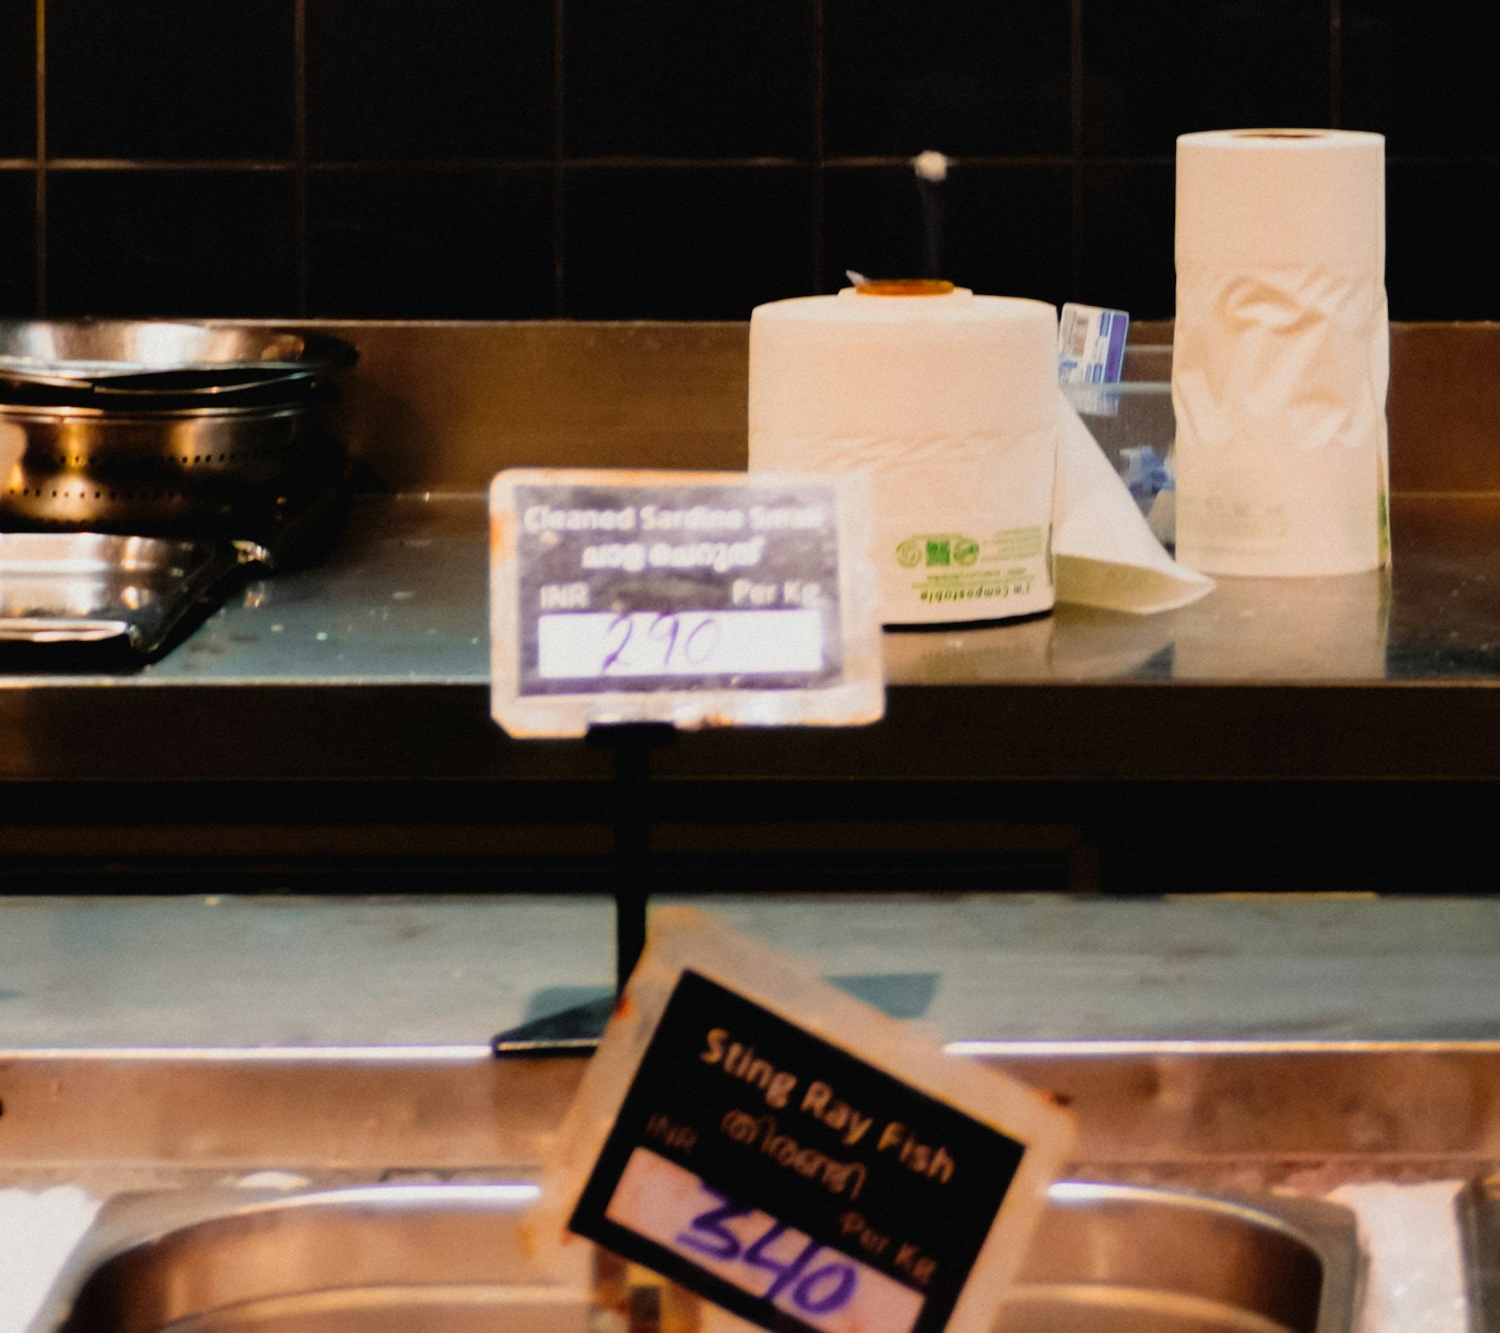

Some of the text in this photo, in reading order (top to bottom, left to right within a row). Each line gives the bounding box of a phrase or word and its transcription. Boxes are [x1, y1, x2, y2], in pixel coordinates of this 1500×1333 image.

[524, 504, 636, 531] Cleaned
[732, 579, 776, 606] Per
[699, 1026, 957, 1186] Sting Ray Fish
[839, 1209, 892, 1255] Per
